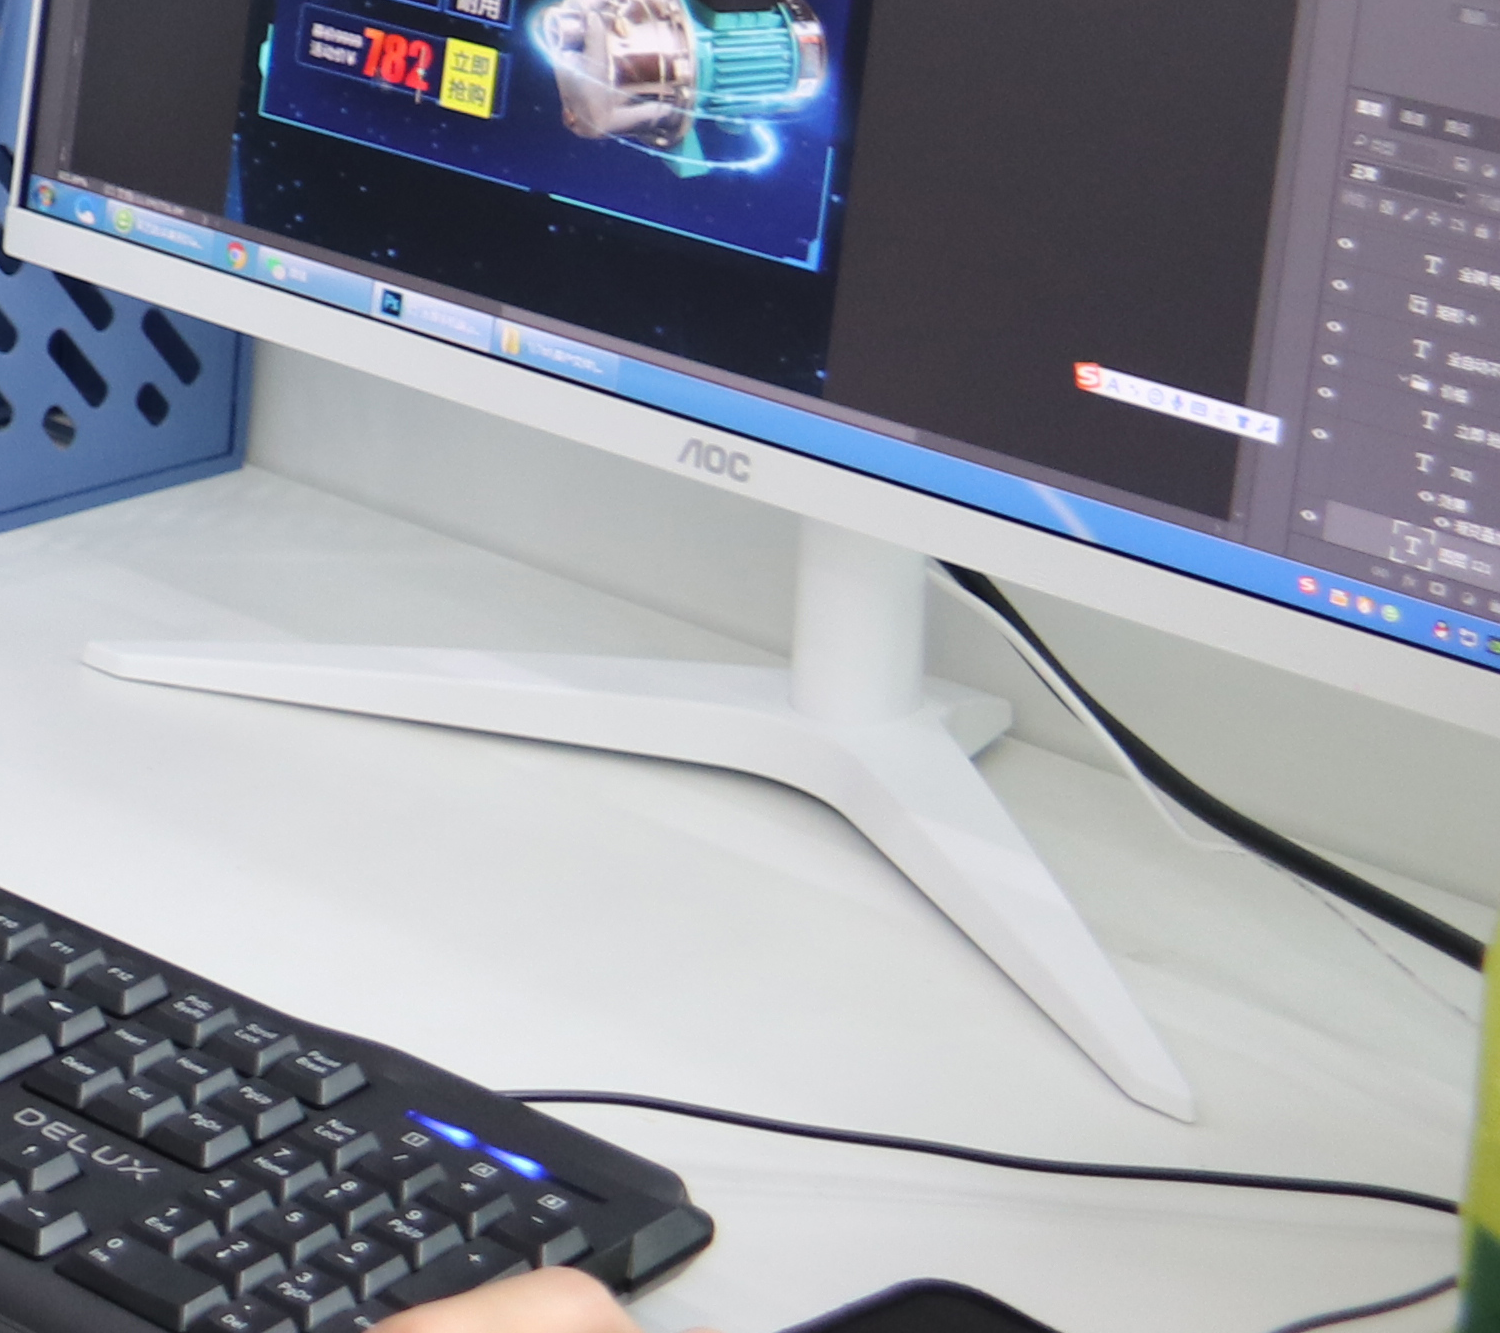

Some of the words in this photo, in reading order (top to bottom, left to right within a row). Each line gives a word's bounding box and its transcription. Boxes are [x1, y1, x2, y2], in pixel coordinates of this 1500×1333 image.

[363, 27, 435, 92] 782
[453, 50, 490, 77] 立即
[677, 437, 751, 483] AOC
[12, 1107, 161, 1183] DELUX
[253, 1155, 290, 1177] Home
[144, 1215, 175, 1234] End
[387, 1218, 425, 1240] PgUp
[88, 1246, 111, 1263] Ins
[277, 1281, 315, 1302] PgDn
[220, 1312, 249, 1330] Del
